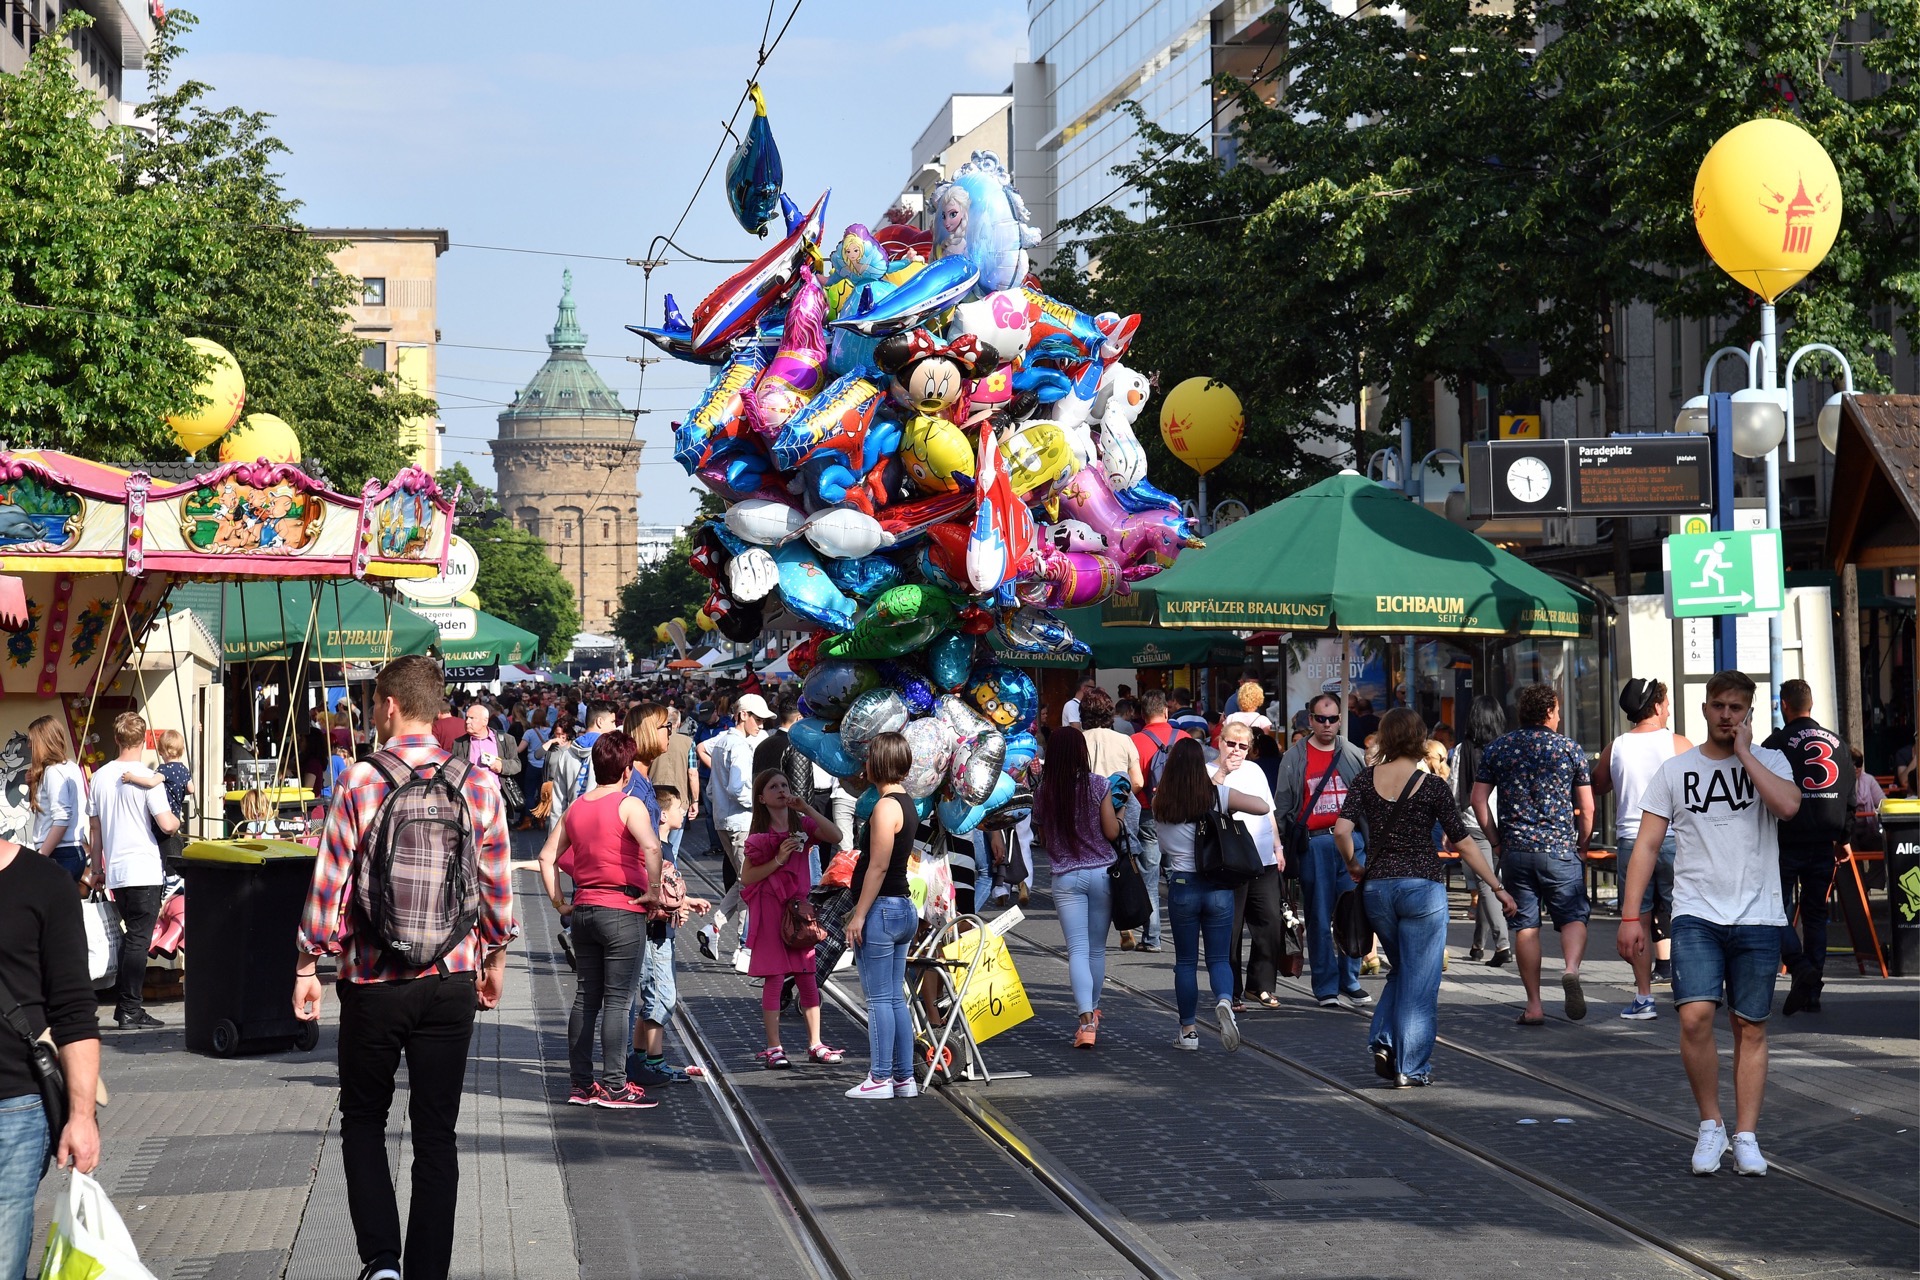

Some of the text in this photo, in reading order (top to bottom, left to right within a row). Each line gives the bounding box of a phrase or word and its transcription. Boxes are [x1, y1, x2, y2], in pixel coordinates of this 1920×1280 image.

[695, 363, 758, 439] SPIDER-MAN
[1579, 446, 1633, 457] Paradeplatz
[1166, 598, 1327, 617] KURPFÄLZER BRAUKUNST
[1375, 595, 1465, 614] EICHBAUM
[417, 611, 453, 619] etzgerei
[1438, 614, 1478, 626] SEIT 1679
[326, 629, 394, 646] EICHBAUM
[224, 640, 286, 654] AUKUNST
[370, 645, 402, 655] SEIT 679
[444, 650, 492, 661] RAUKUNST
[995, 649, 1085, 663] PFÄLZER BRAUKUNST
[1131, 652, 1171, 664] EICHBAUM
[1307, 663, 1365, 679] BE REDY
[1802, 740, 1840, 791] 3
[1683, 767, 1756, 815] RAW
[1315, 804, 1338, 812] EXPLO
